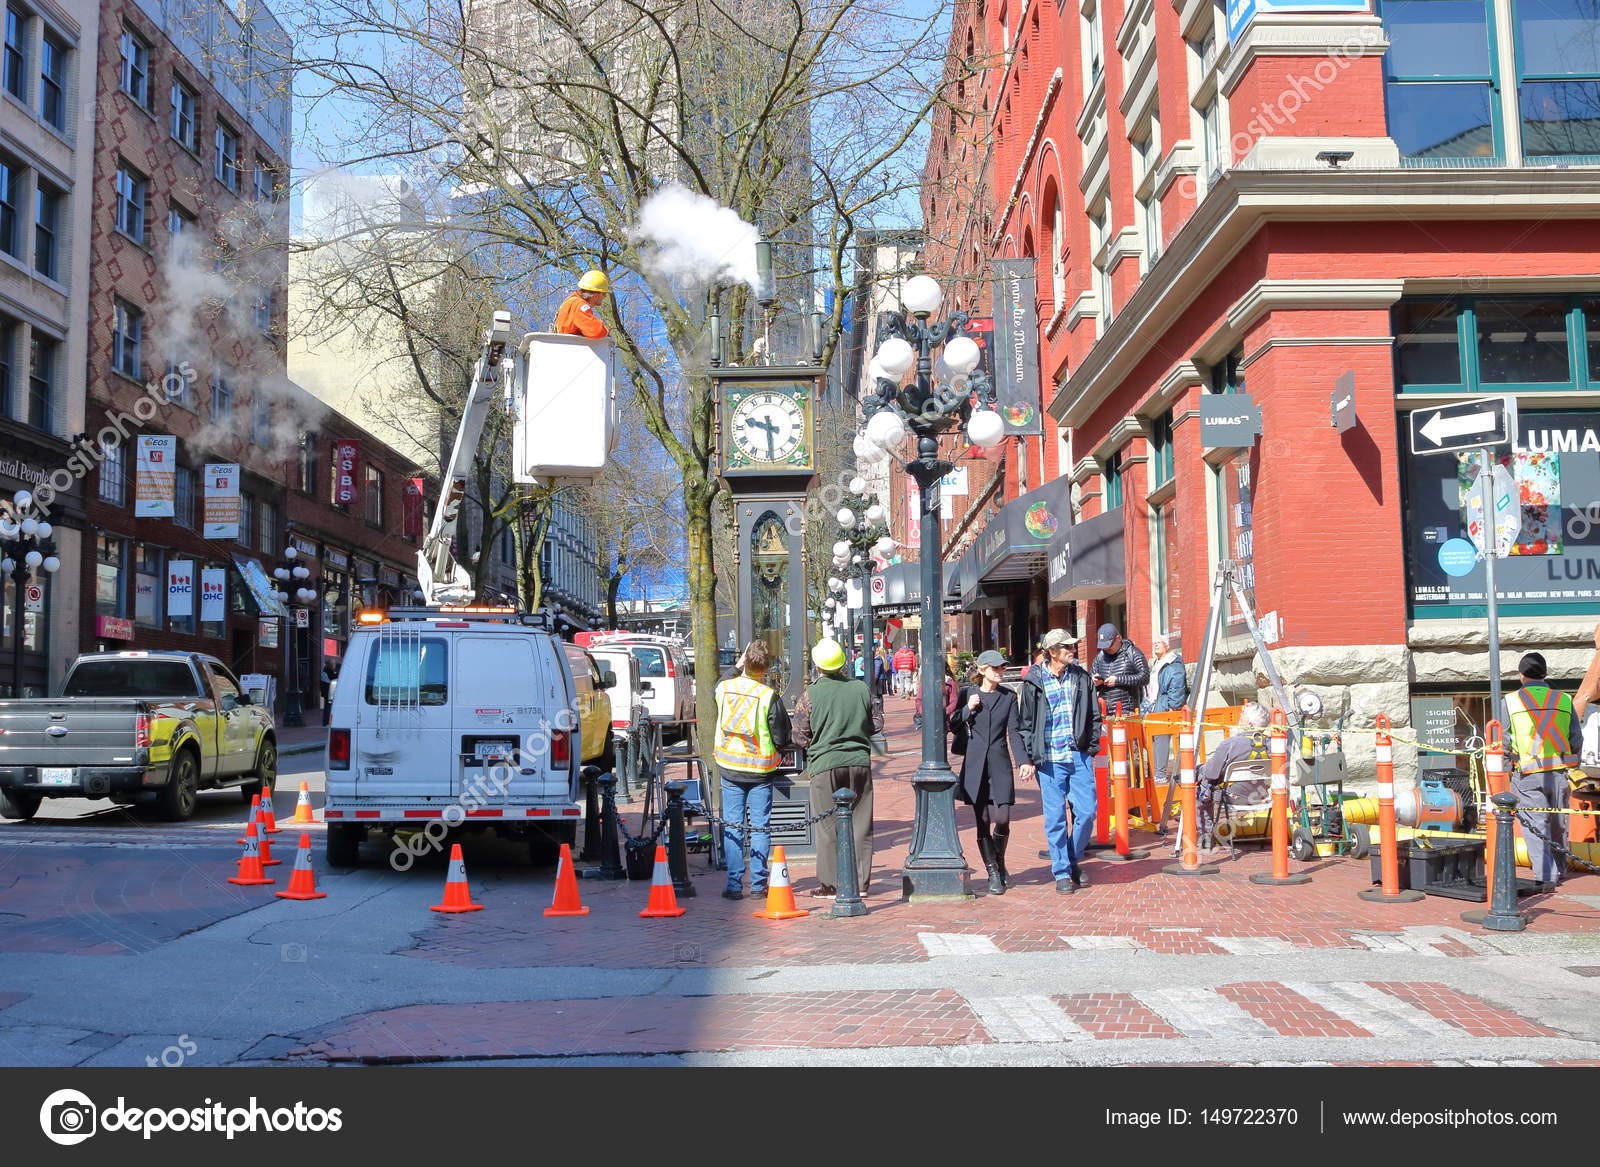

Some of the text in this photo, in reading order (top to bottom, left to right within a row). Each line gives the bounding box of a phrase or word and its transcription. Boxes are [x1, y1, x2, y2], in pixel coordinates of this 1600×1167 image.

[1205, 417, 1242, 426] LUMAS
[169, 585, 192, 593] OHC
[202, 592, 224, 600] OHC
